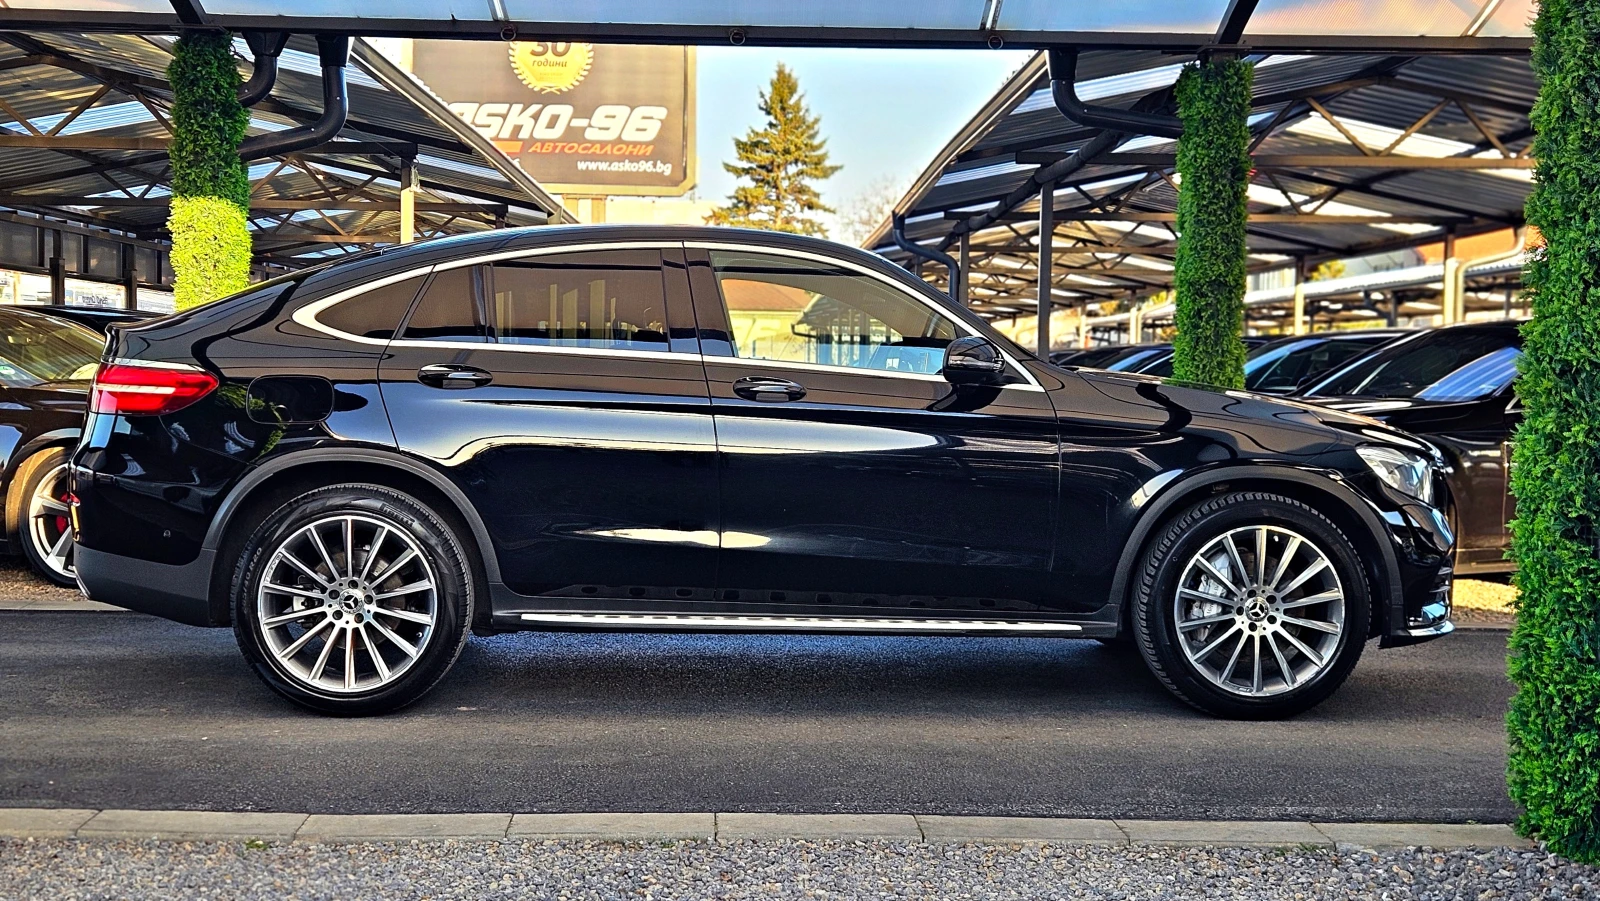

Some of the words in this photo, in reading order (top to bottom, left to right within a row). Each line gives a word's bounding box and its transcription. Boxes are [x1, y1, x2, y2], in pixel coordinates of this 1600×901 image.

[532, 58, 567, 68] години
[528, 142, 654, 156] АВТОСАЛОНИ
[577, 159, 672, 175] www.asko96.bg
